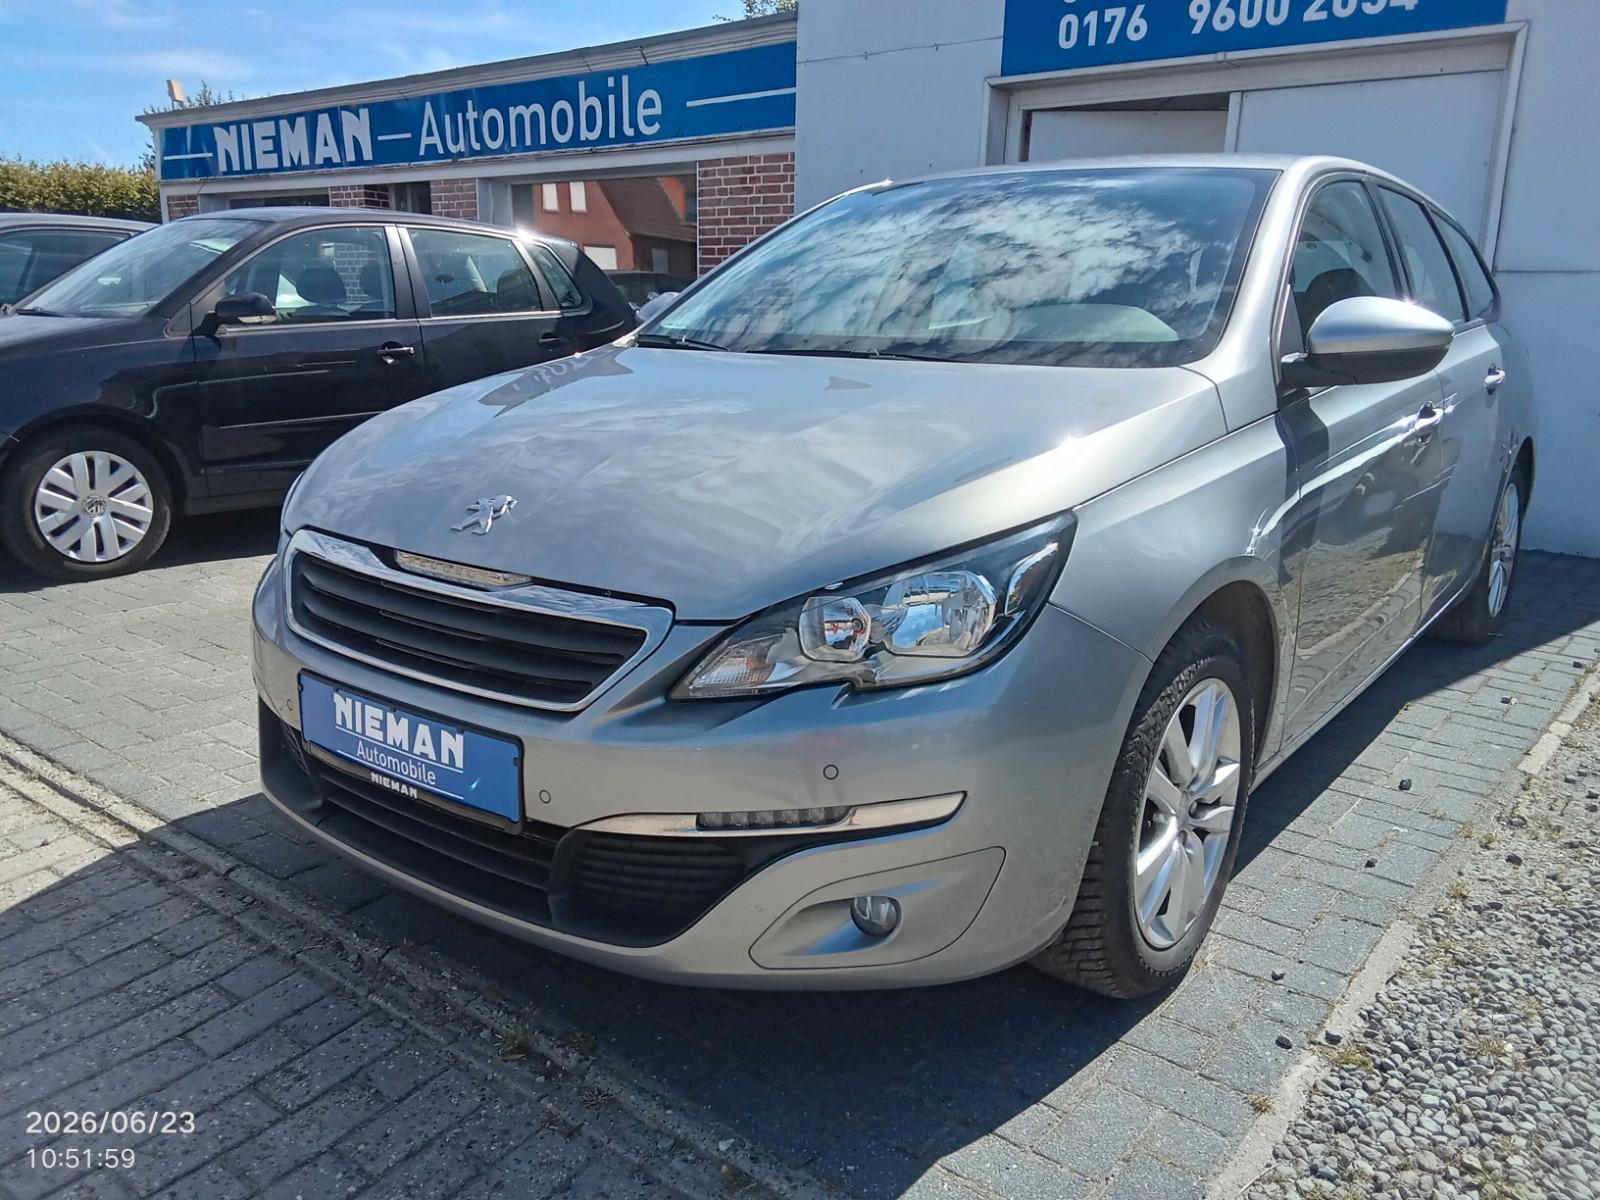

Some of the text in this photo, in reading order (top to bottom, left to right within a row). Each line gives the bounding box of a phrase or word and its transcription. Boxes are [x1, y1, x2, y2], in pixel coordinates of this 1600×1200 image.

[1058, 0, 1419, 49] 0176 9600 20
[213, 75, 662, 172] NIEMAN Automobile
[333, 692, 464, 769] NIEMAN
[356, 741, 436, 785] Automobile
[371, 772, 417, 799] NIEMAN
